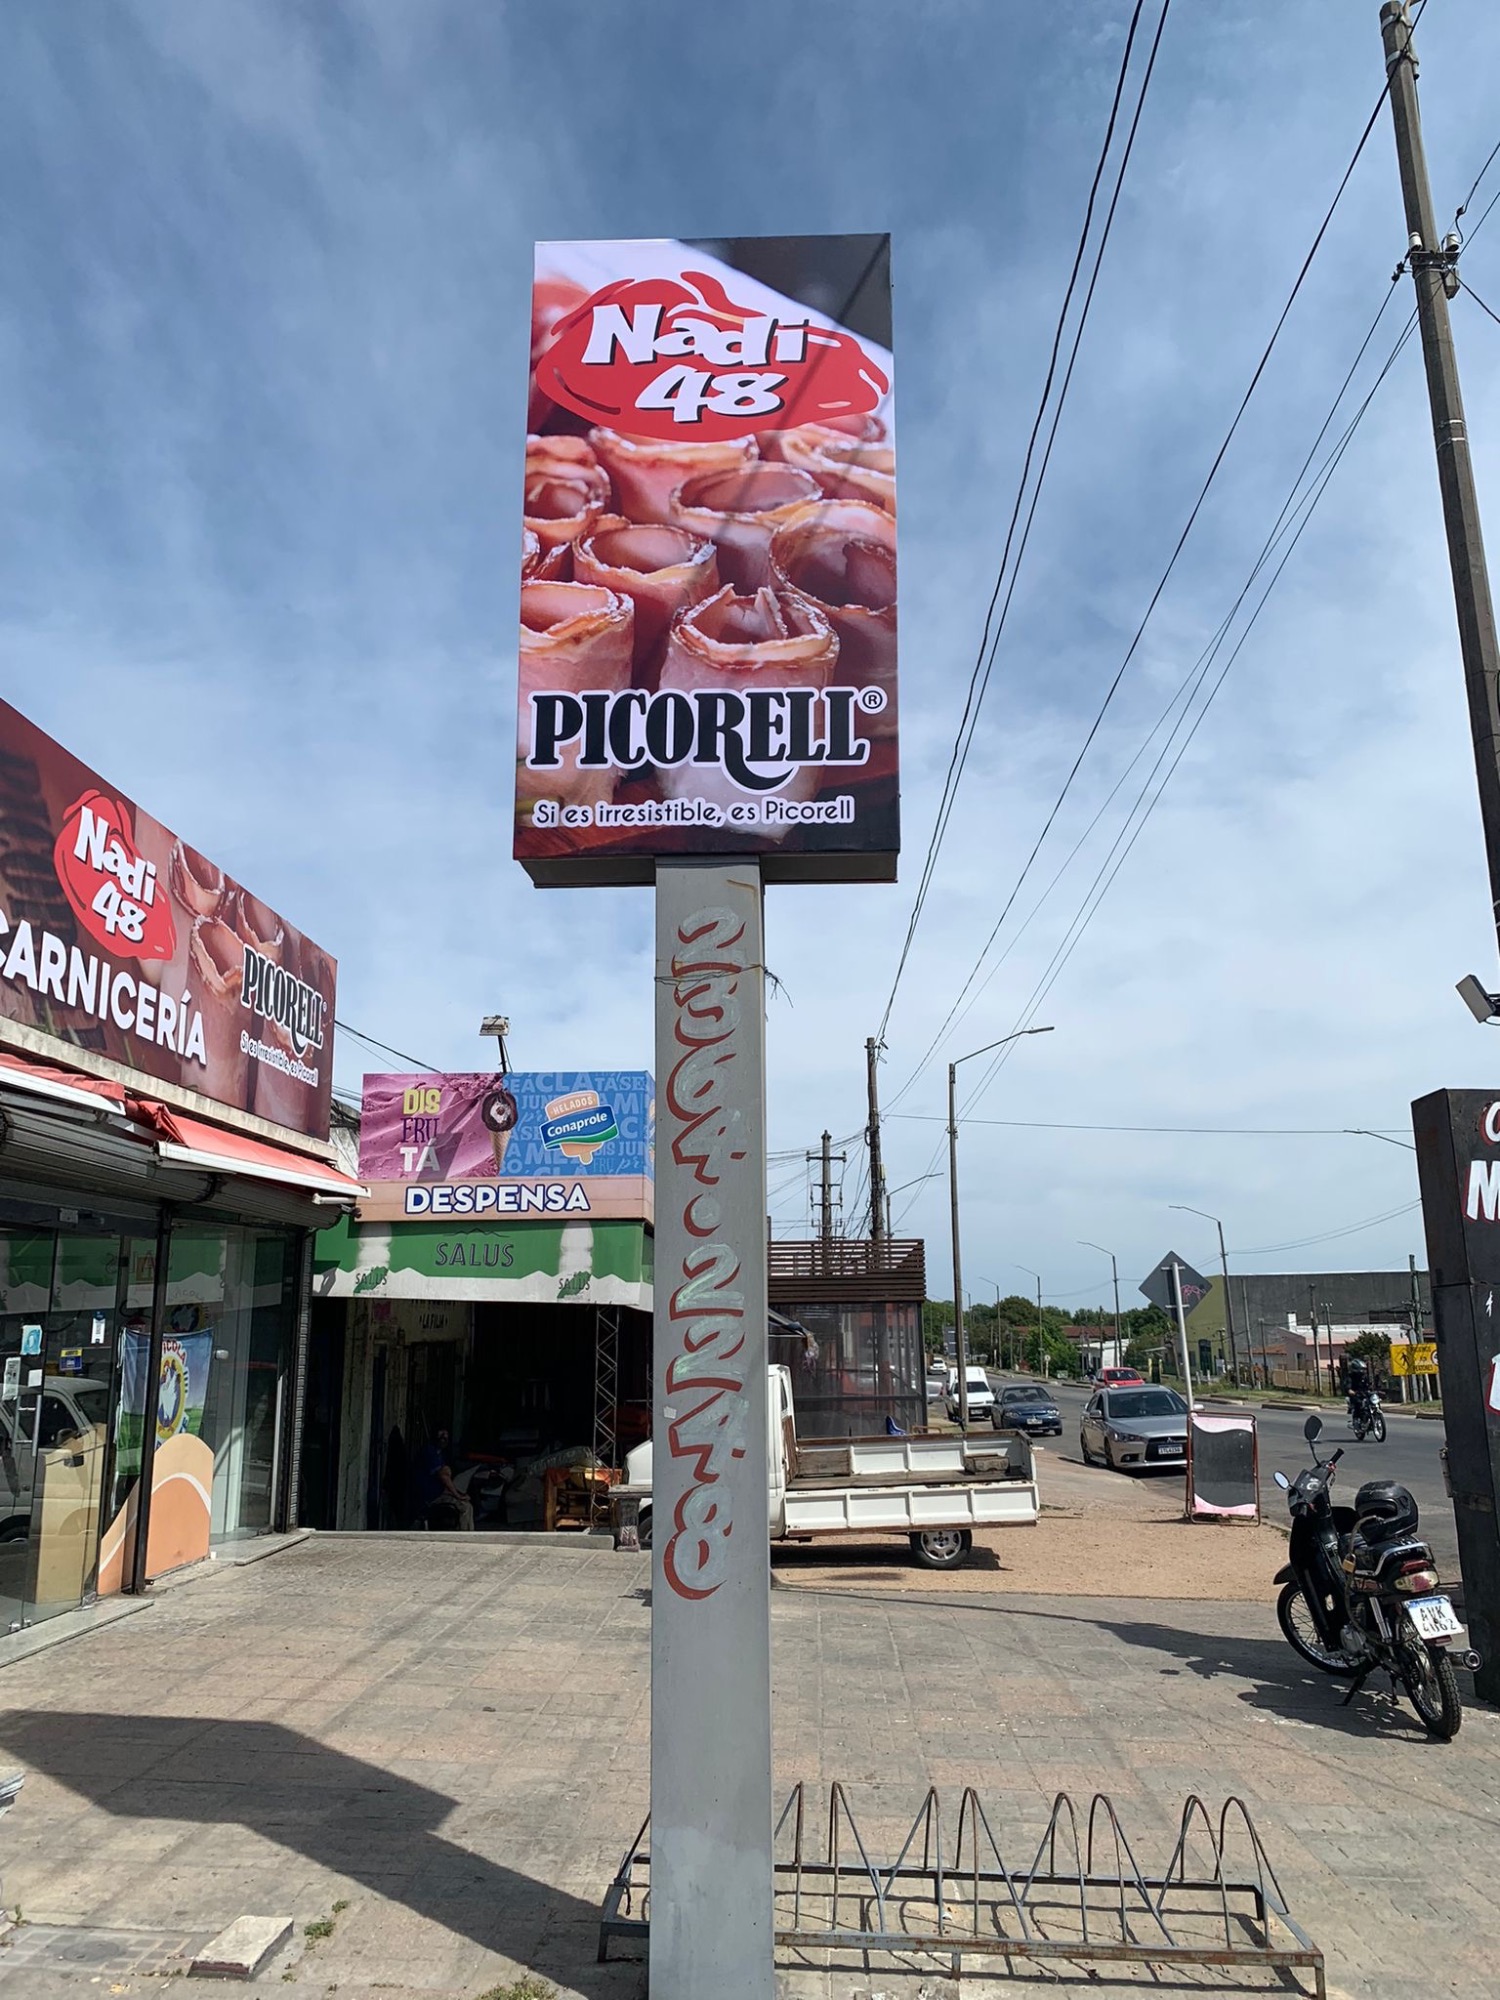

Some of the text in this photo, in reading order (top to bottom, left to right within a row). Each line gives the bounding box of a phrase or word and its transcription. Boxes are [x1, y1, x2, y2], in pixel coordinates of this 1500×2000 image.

[581, 303, 807, 366] Nadi
[635, 364, 788, 423] 48
[536, 799, 851, 825] Si es irresistible, es Picorell
[73, 805, 157, 906] Nadi
[91, 880, 147, 942] 48
[403, 1088, 442, 1115] DIS
[552, 1095, 595, 1116] HELADOS
[401, 1117, 440, 1143] FRU
[547, 1112, 608, 1137] Conaprole
[400, 1138, 440, 1172] TÁ
[405, 1183, 590, 1214] DESPENSA
[435, 1242, 514, 1267] SALUS
